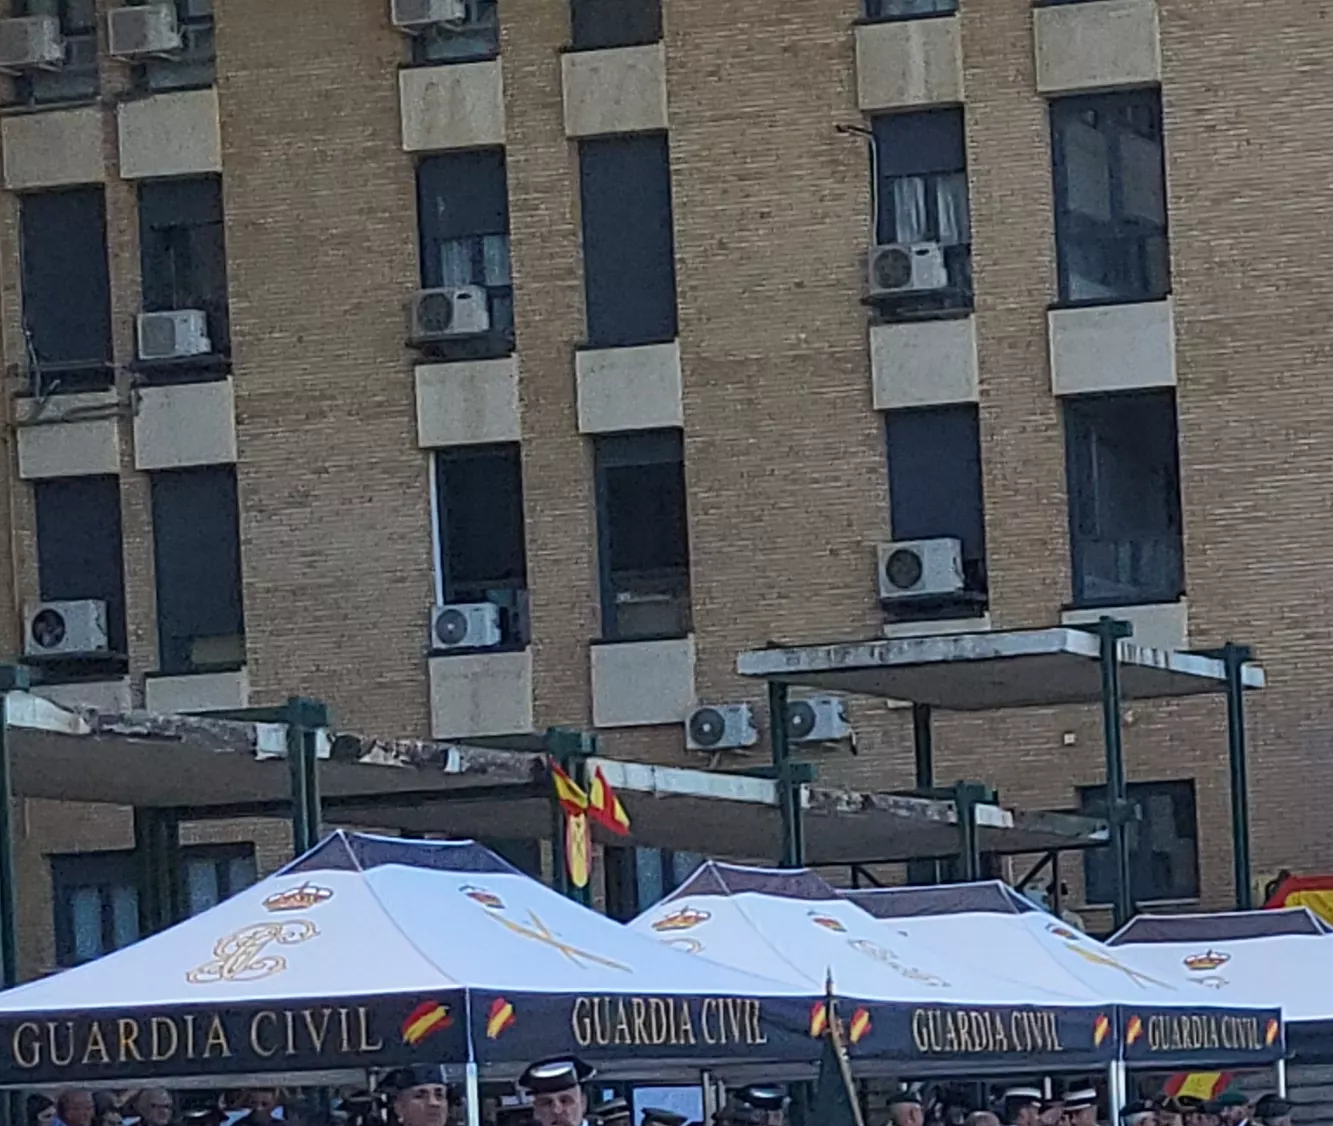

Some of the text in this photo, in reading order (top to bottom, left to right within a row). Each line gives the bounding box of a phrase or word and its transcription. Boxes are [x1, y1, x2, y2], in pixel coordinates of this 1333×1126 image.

[12, 1005, 384, 1069] GUARDIA CIVIL
[571, 996, 769, 1047] GUARDIA CIVIL
[912, 1007, 1064, 1052] GUARDIA CIVIL
[1148, 1015, 1264, 1051] GUARDIA CIVIL
